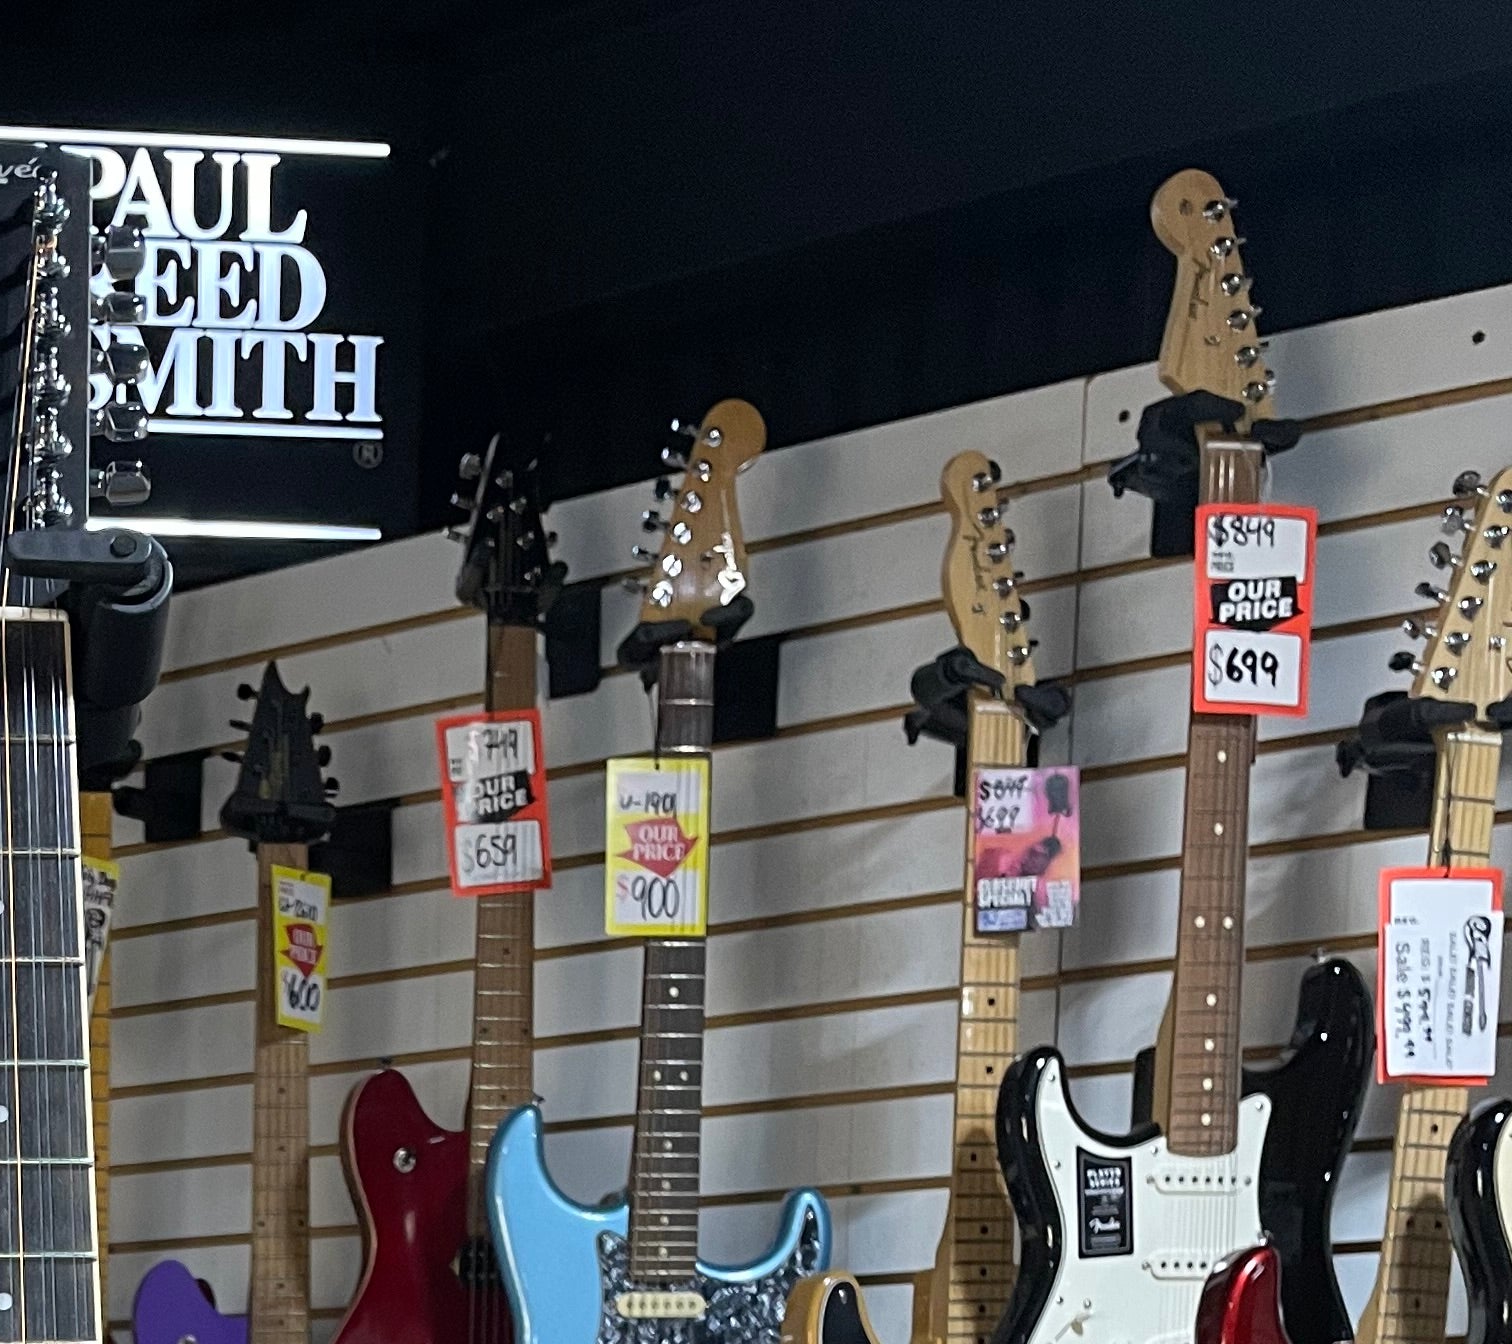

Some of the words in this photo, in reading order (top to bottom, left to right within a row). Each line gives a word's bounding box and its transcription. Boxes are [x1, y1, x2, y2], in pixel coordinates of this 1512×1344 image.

[60, 145, 308, 244] PAUL
[1208, 514, 1276, 548] $849
[1227, 579, 1282, 601] OUR
[1218, 596, 1294, 623] PRICE
[1207, 643, 1279, 689] $699
[637, 824, 679, 844] OUR
[632, 841, 686, 863] PRICE
